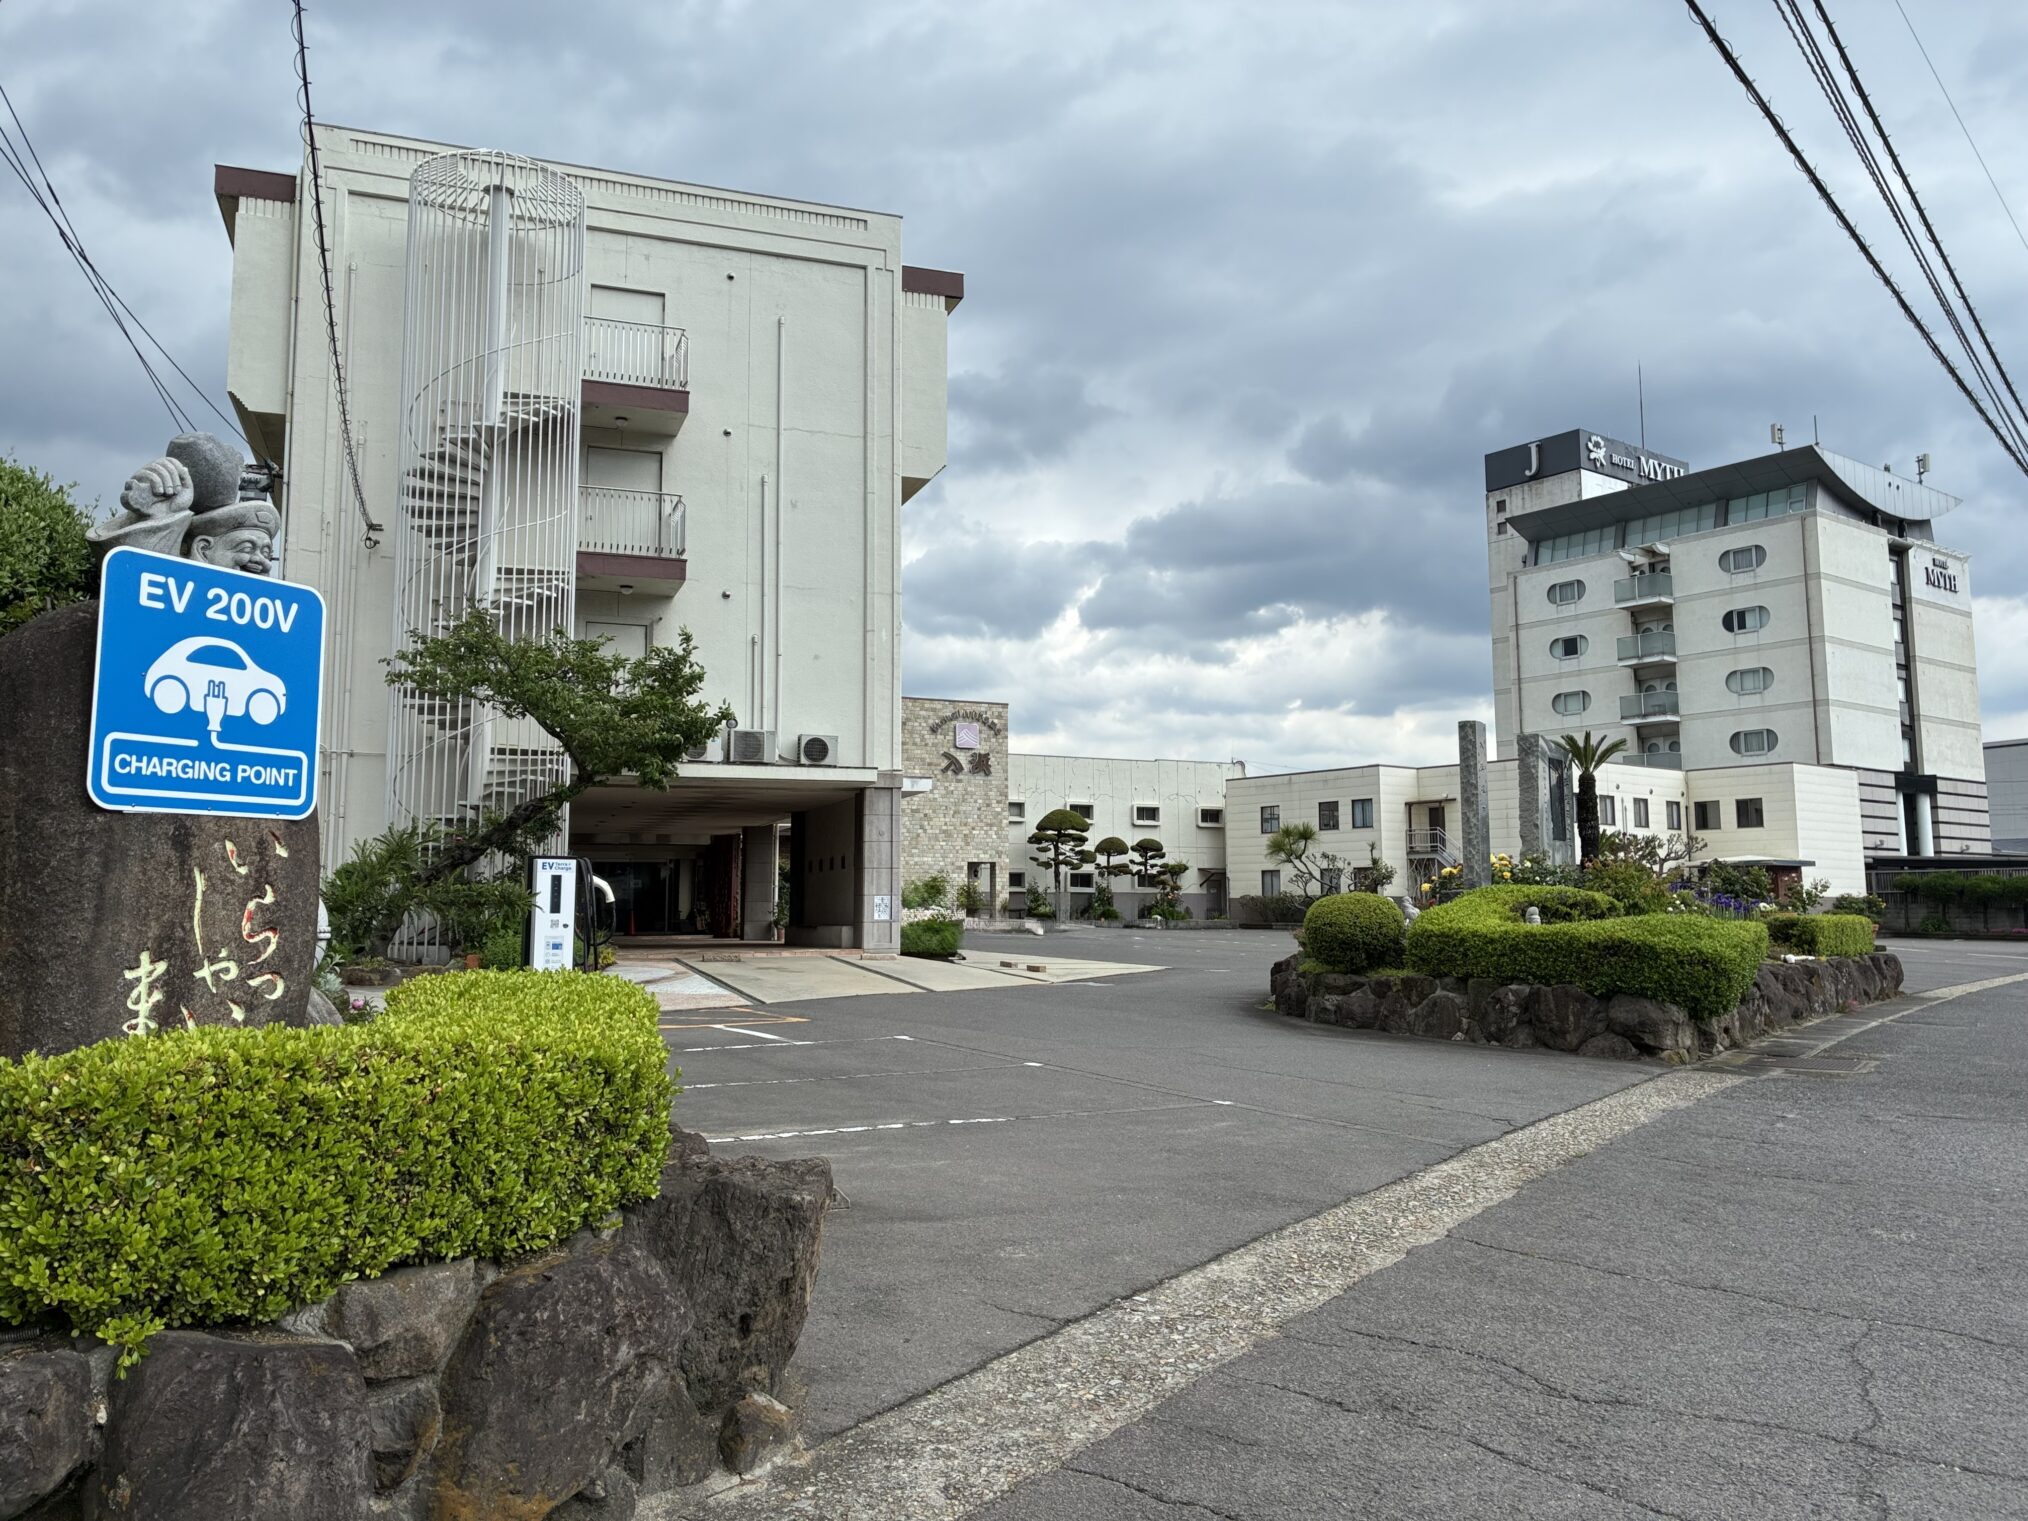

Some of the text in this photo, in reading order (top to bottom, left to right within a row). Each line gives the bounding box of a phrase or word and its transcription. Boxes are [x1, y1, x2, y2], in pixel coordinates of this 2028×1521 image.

[1525, 442, 1541, 476] J
[1611, 453, 1637, 470] HOTEL
[1925, 566, 1959, 593] MYTH
[139, 572, 299, 633] EV 200V
[114, 753, 298, 787] CHARGING POINT
[541, 861, 554, 870] EV
